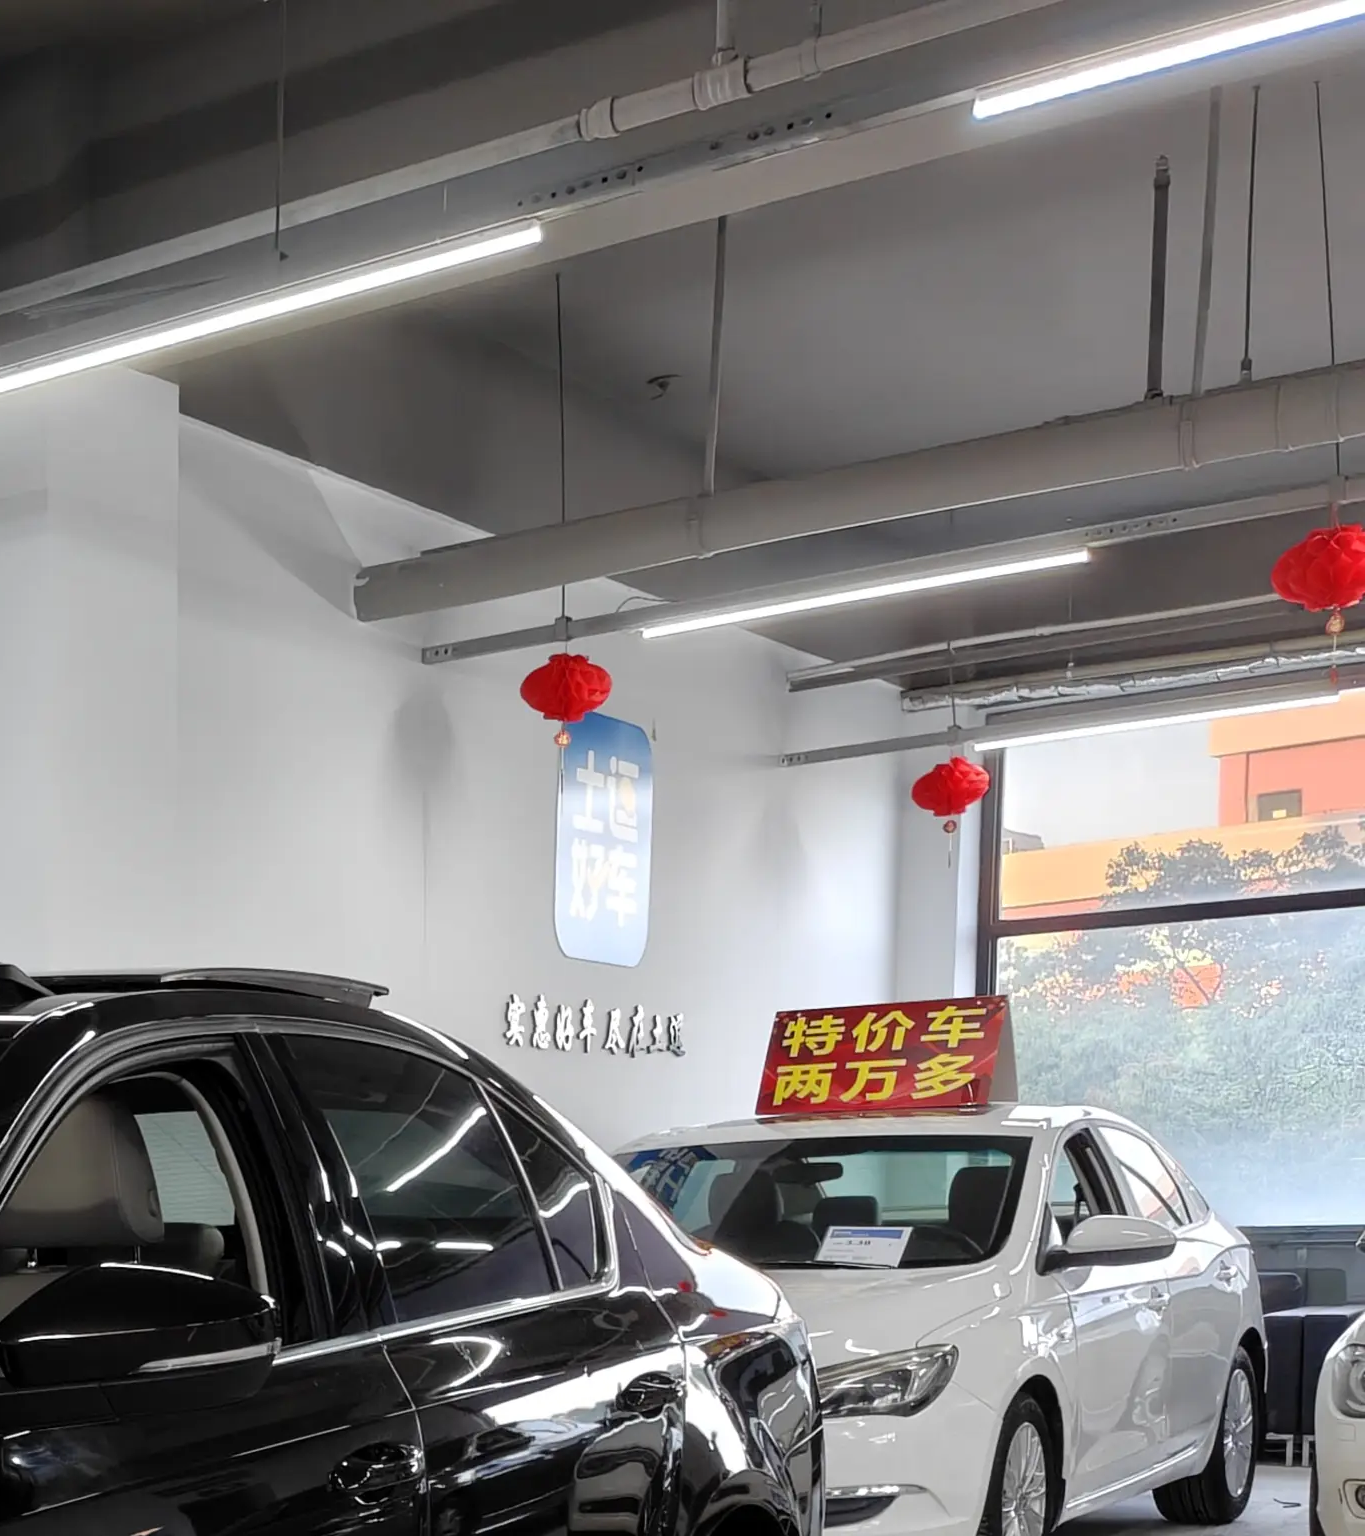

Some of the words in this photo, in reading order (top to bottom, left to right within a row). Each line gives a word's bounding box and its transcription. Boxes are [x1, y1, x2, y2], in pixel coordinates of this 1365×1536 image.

[572, 749, 639, 843] 士运
[569, 837, 638, 928] 好车
[781, 1005, 987, 1058] 特价车
[772, 1053, 976, 1106] 两万多
